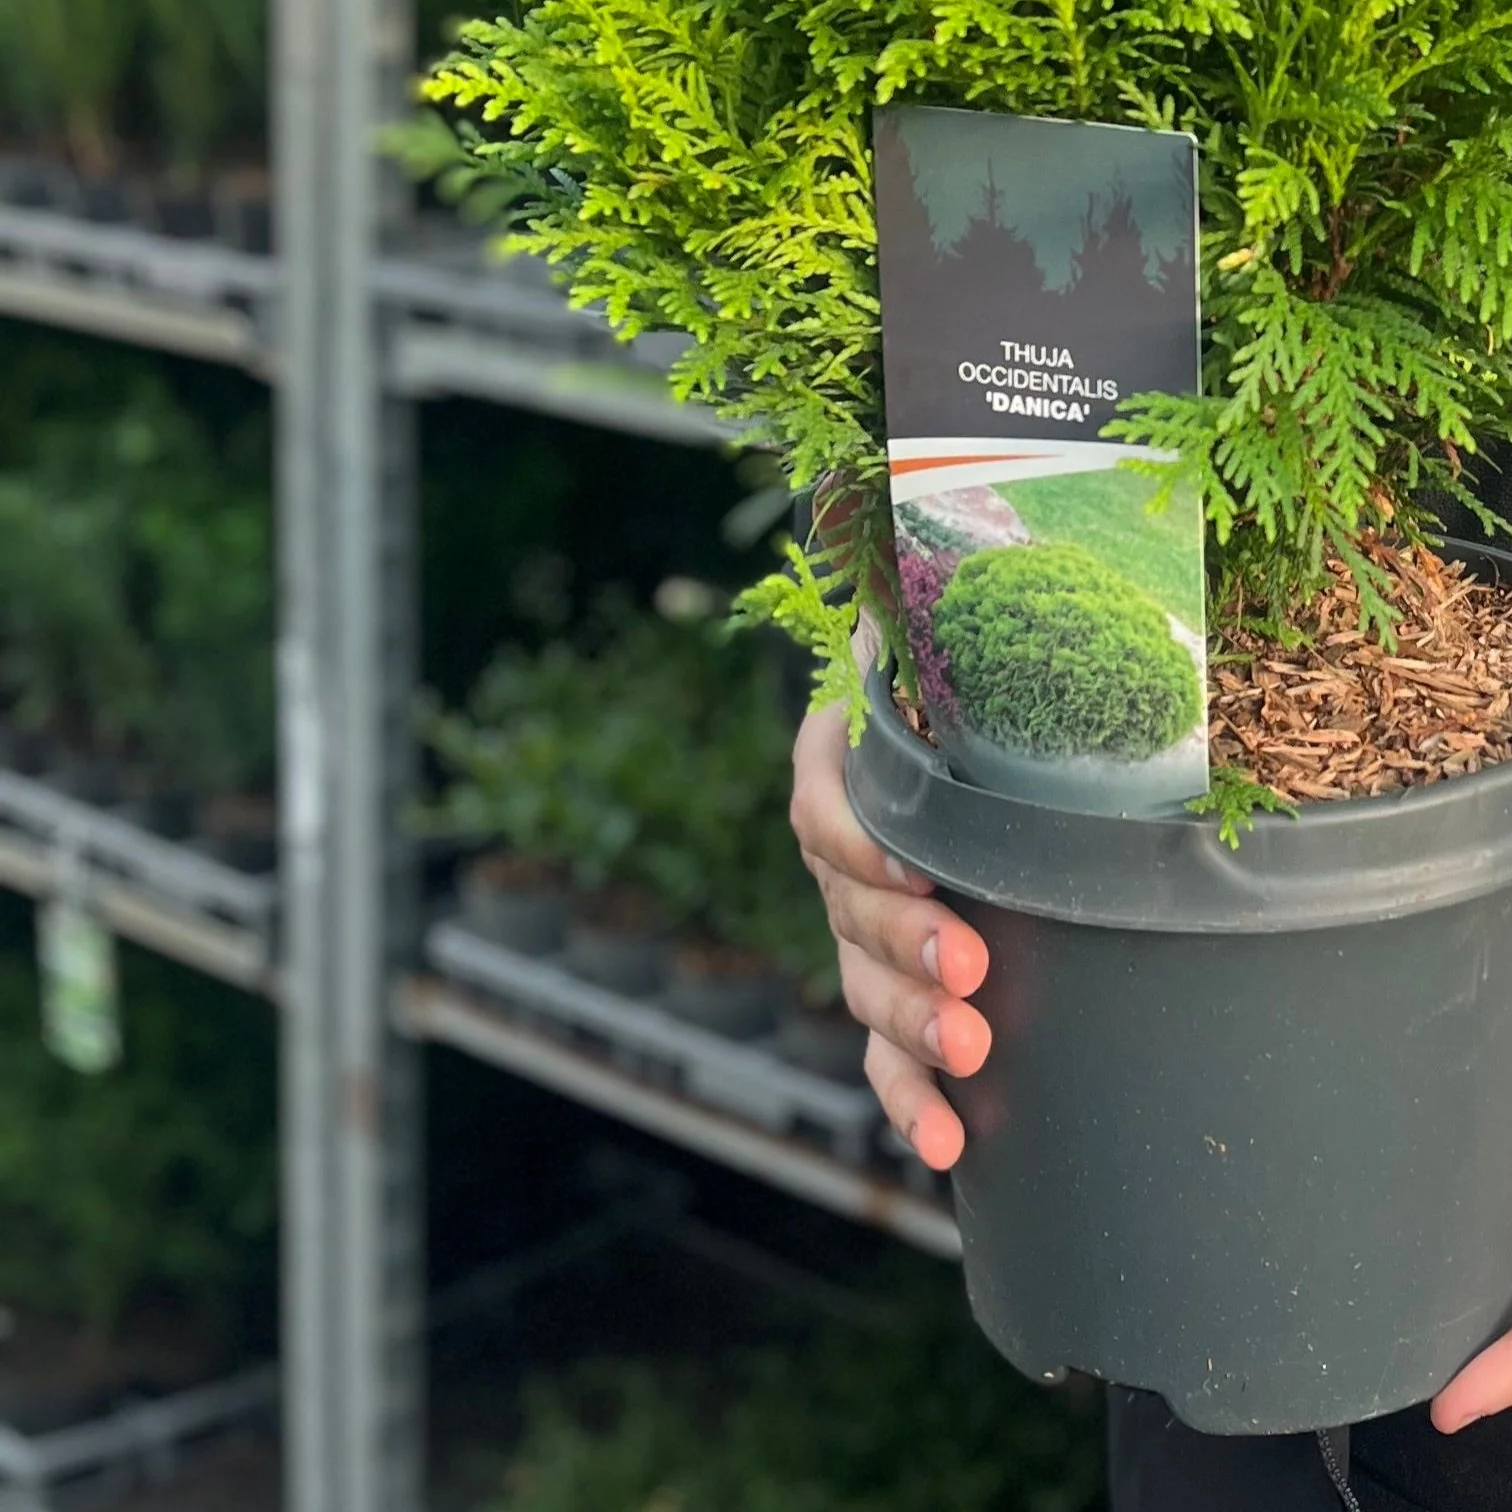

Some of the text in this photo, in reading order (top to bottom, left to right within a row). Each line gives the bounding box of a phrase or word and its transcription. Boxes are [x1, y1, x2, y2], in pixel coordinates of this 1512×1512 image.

[1000, 340, 1075, 370] THUJA
[958, 361, 1119, 401] OCCIDENTALIS
[985, 391, 1091, 423] 'DANICA'
